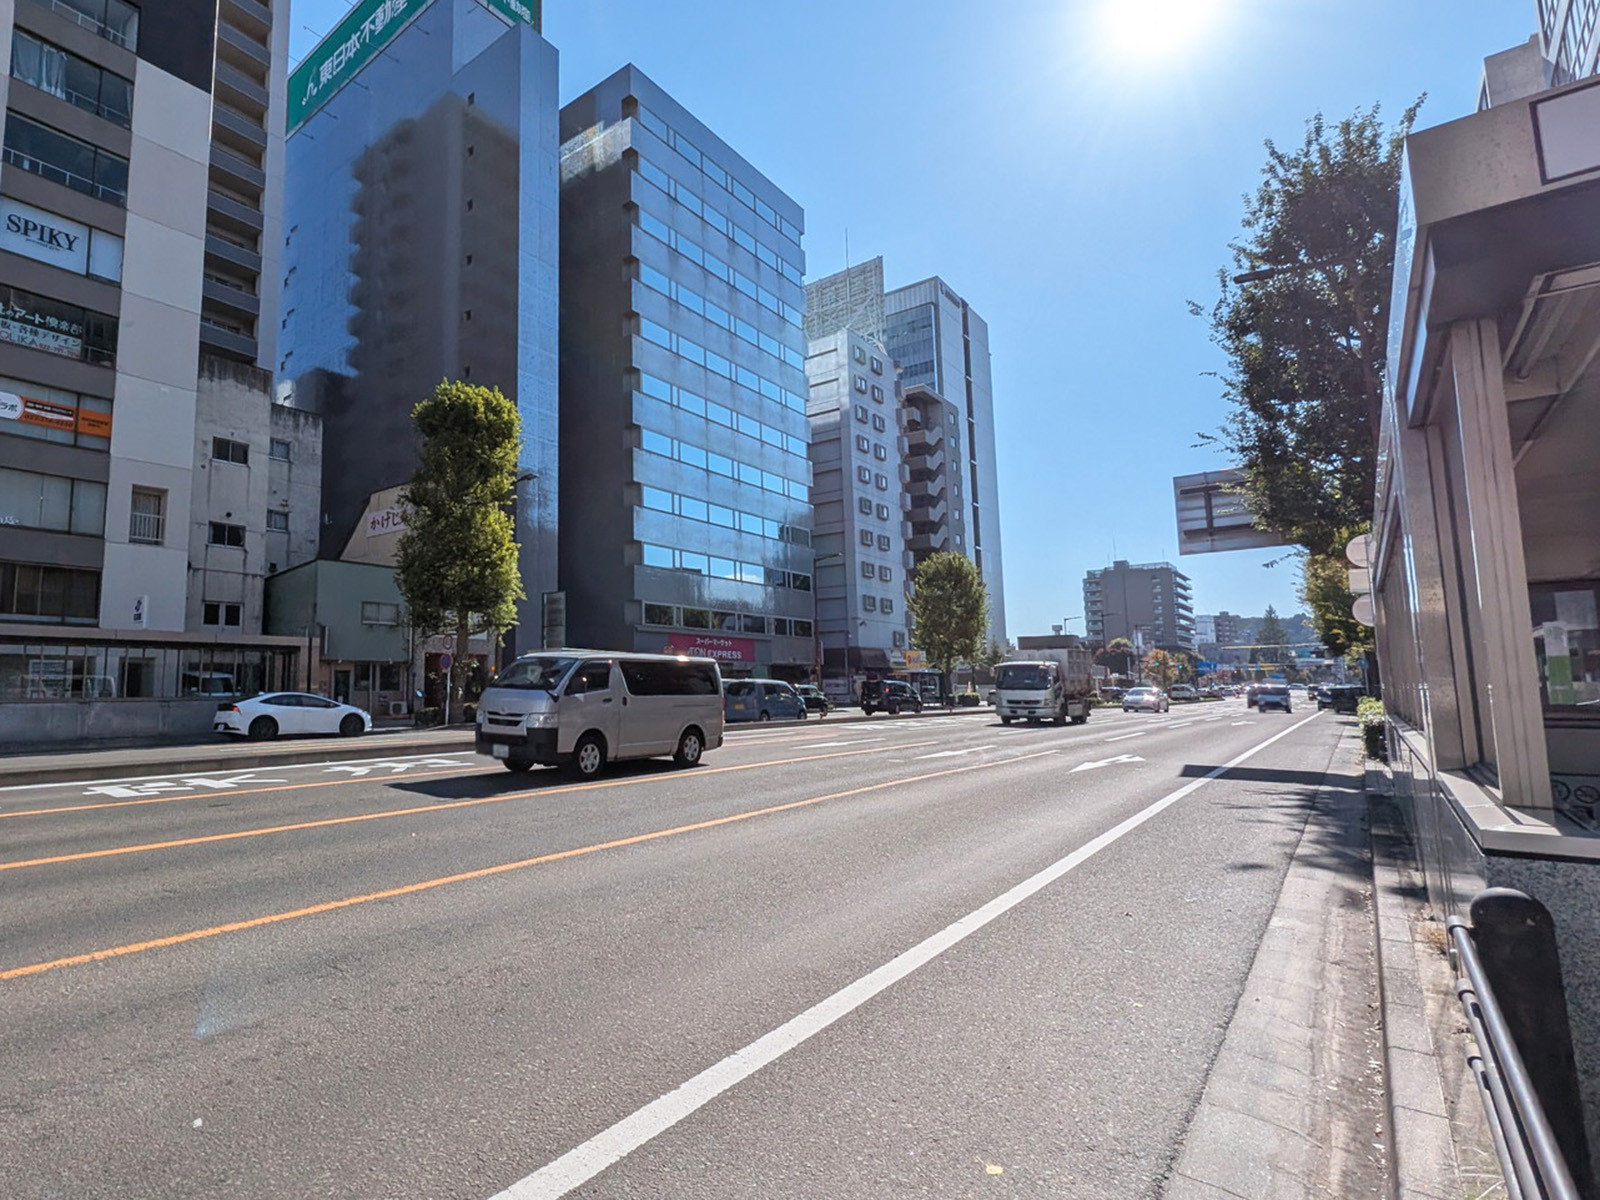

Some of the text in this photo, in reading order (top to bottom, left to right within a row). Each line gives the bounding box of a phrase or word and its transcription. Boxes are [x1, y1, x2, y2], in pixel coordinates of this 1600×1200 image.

[6, 213, 80, 252] SPIKY
[696, 637, 732, 647] スーパーマーケット
[708, 649, 742, 660] EXPRESS
